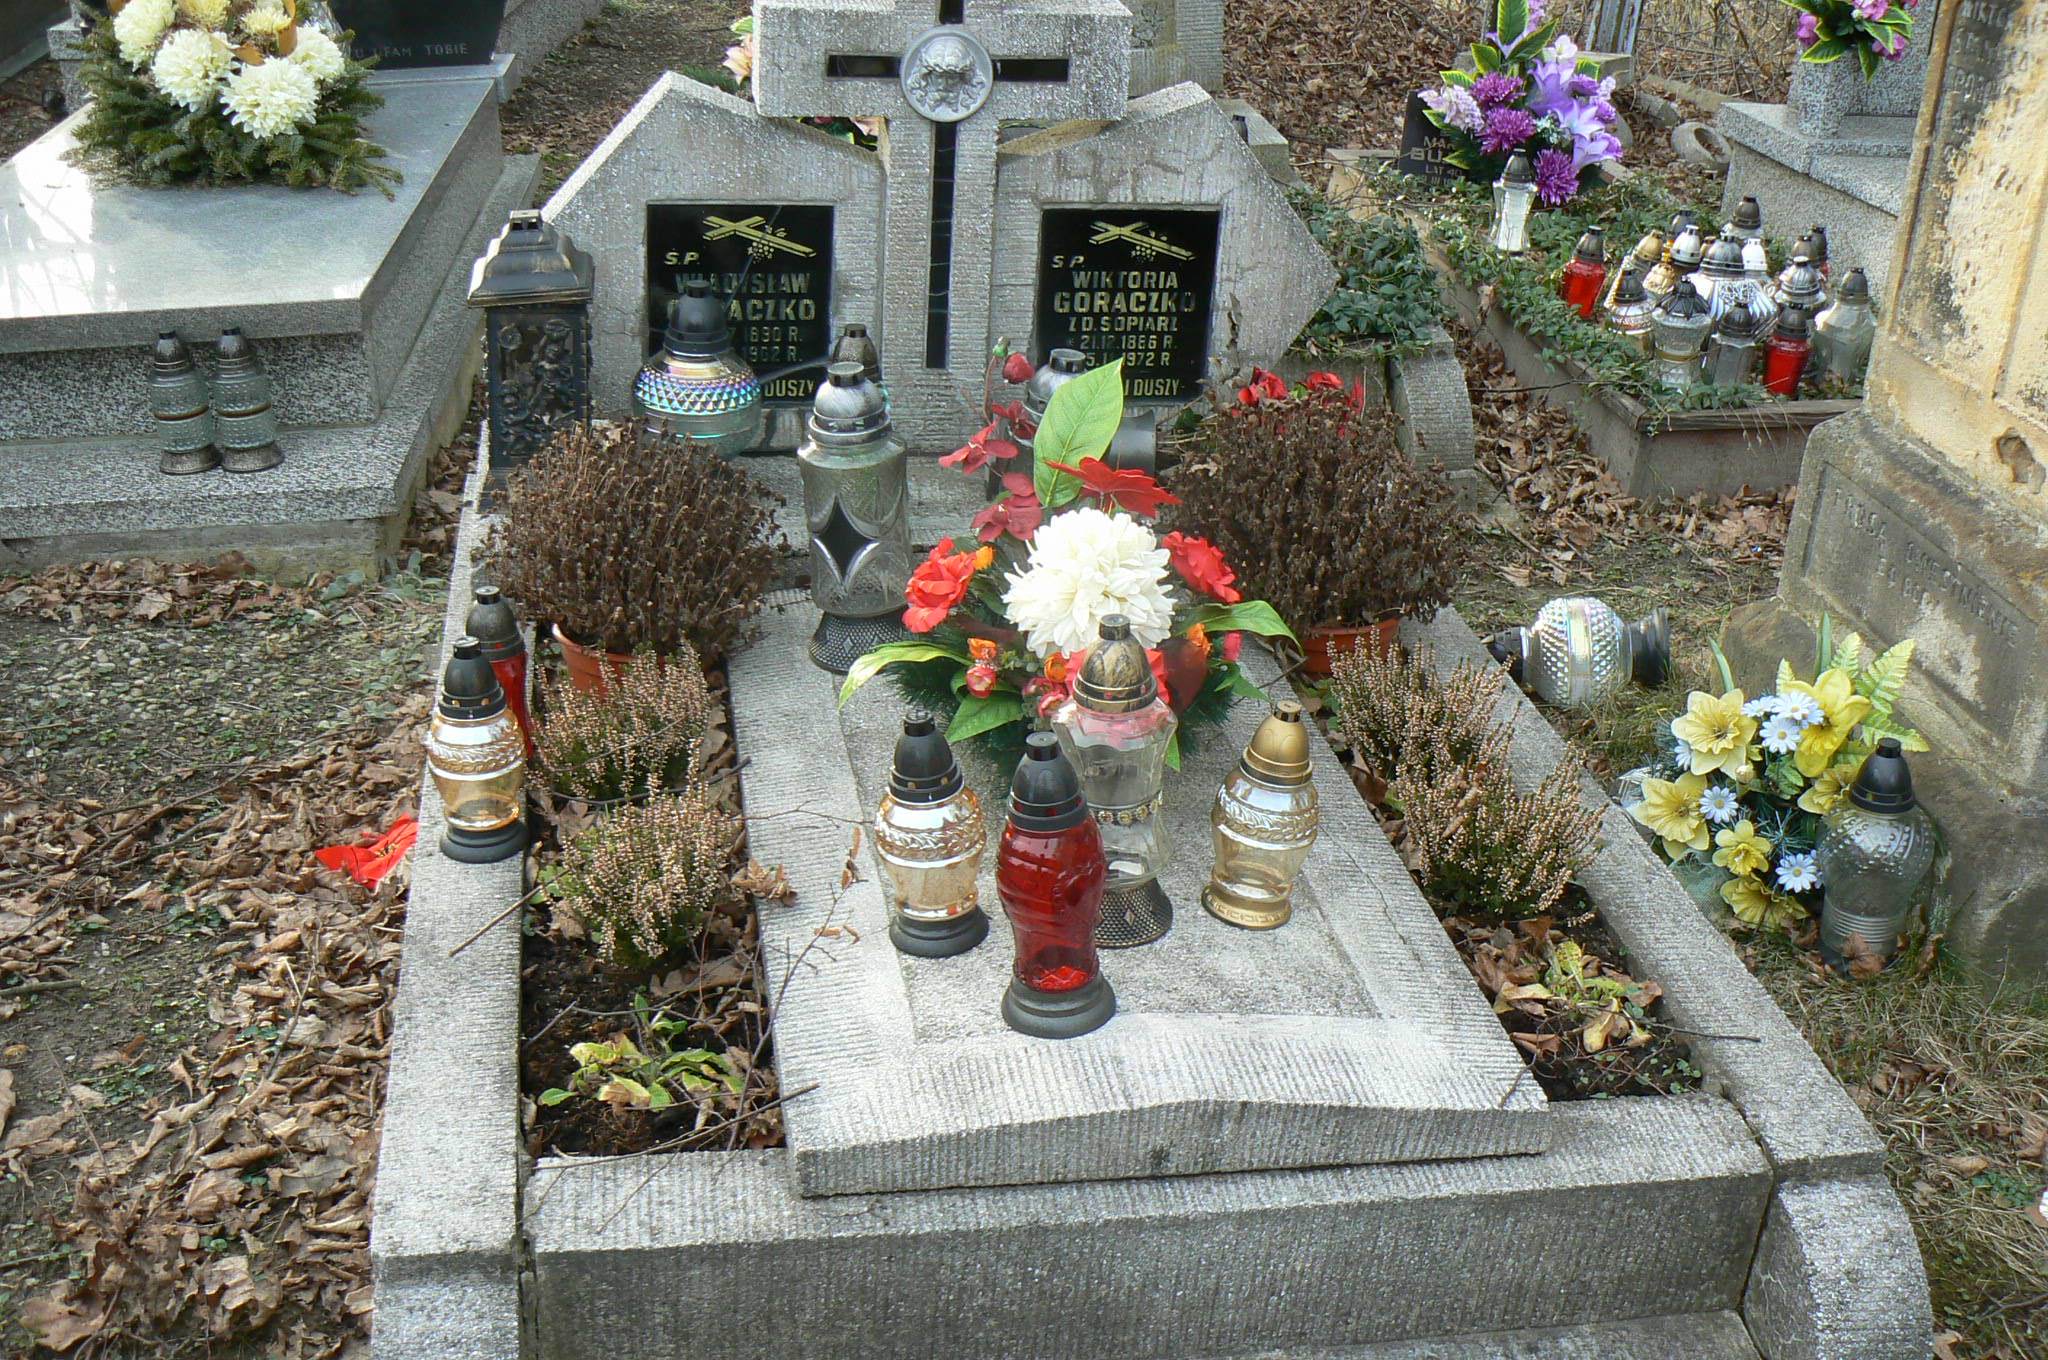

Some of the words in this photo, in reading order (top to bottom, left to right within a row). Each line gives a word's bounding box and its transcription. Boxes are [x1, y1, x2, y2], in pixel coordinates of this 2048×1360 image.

[424, 42, 468, 56] TOBIE
[1071, 271, 1179, 289] WIKTORIA
[1053, 291, 1196, 314] GORACZKO
[764, 378, 816, 398] DUSZY
[1133, 378, 1180, 397] DUSZY
